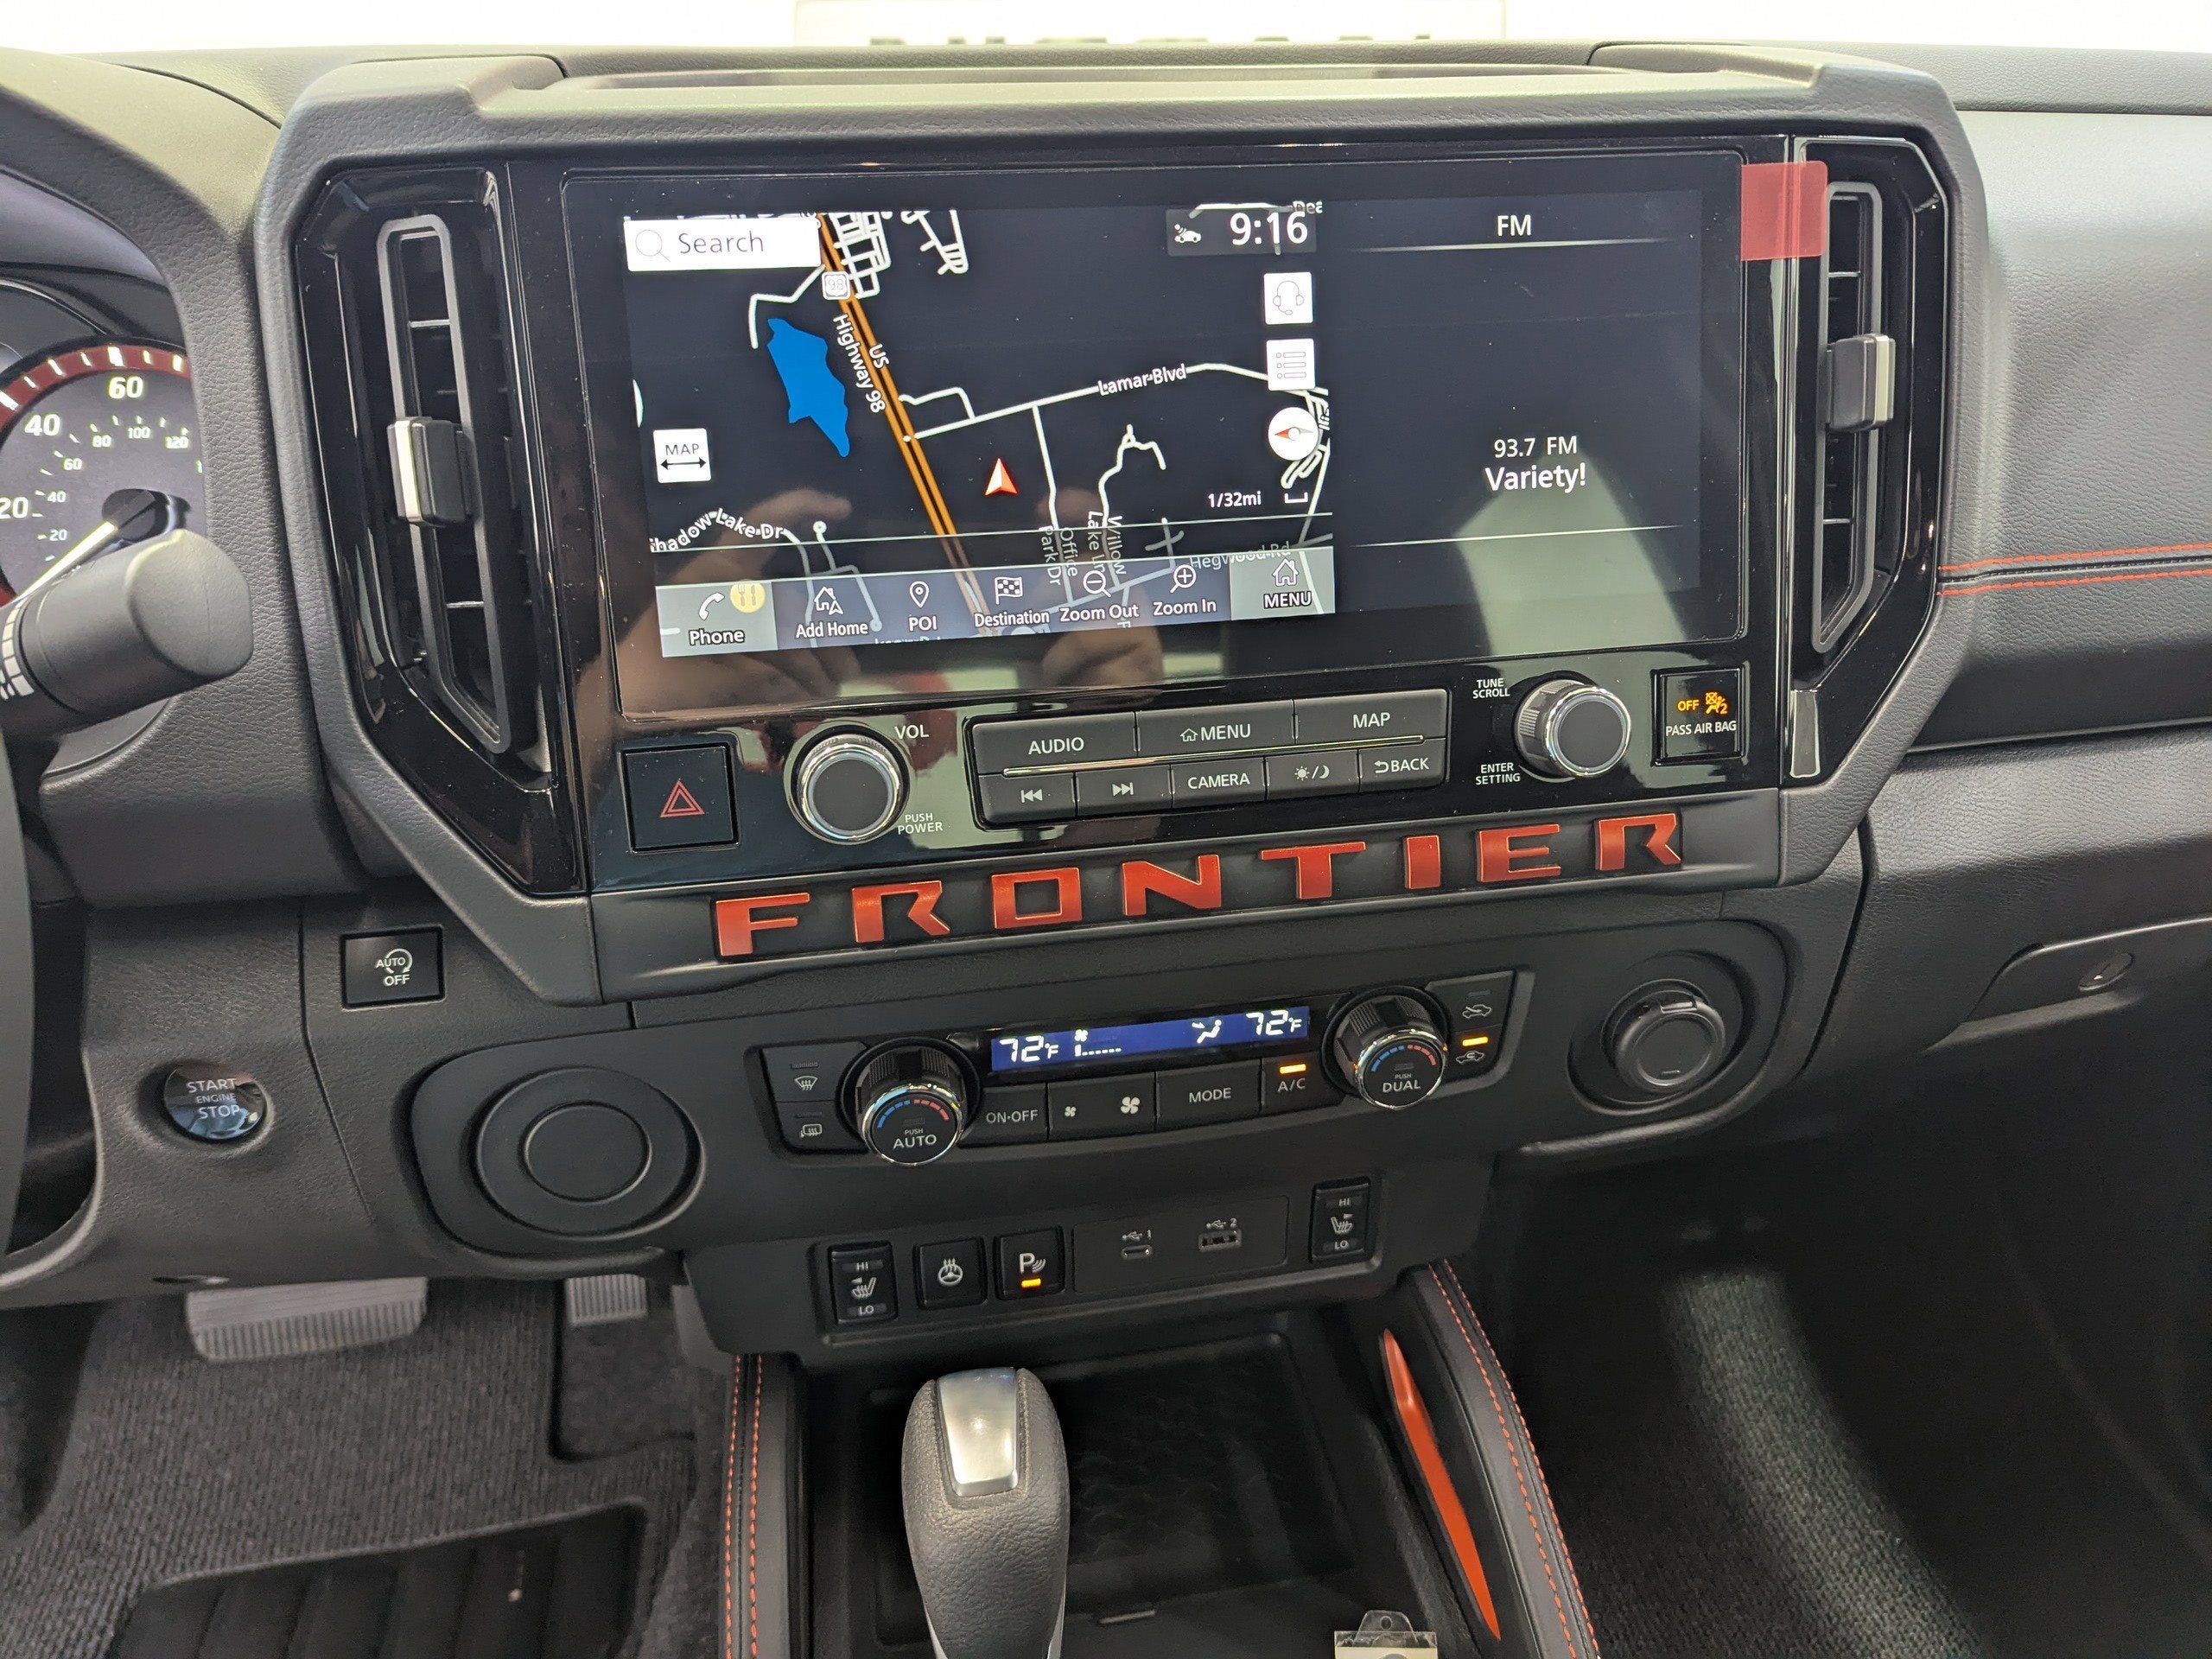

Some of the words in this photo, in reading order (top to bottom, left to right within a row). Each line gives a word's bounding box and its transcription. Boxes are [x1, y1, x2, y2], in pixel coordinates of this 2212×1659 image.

[1230, 211, 1308, 245] 9:16
[1497, 214, 1532, 237] FM
[677, 229, 765, 255] Search
[827, 278, 846, 292] 98
[832, 314, 874, 389] Highway
[865, 390, 887, 413] 98
[869, 344, 890, 368] US
[108, 376, 144, 398] 60
[1097, 376, 1151, 396] Lamar
[1152, 363, 1187, 385] Blvd
[24, 413, 61, 436] 40
[128, 426, 151, 439] 100
[92, 435, 112, 448] 80
[664, 442, 700, 456] MAP
[1493, 437, 1536, 459] 93.7
[1547, 435, 1578, 455] FM
[63, 458, 83, 471] 60
[1484, 462, 1586, 493] Variety!
[47, 490, 67, 503] 40
[1207, 490, 1262, 509] 1/32mi
[0, 496, 29, 518] 20
[715, 507, 756, 538] Lake
[760, 523, 784, 540] Dr
[1087, 511, 1103, 550] Lake
[49, 528, 67, 541] 20
[1039, 525, 1059, 563] Park
[1047, 566, 1062, 586] Dr
[1153, 600, 1198, 616] Zoom
[1201, 598, 1217, 613] In
[1263, 590, 1313, 609] MENU
[974, 609, 1050, 628] Destination
[1059, 607, 1106, 622] Zoom
[1109, 604, 1140, 619] Out
[795, 623, 824, 639] Add
[827, 621, 868, 638] Home
[908, 615, 938, 632] POI
[689, 628, 746, 646] Phone
[1476, 677, 1504, 689] TUNE
[1472, 686, 1510, 700] SCROLL
[1677, 698, 1700, 712] OFF
[1352, 712, 1391, 729] MAP
[1665, 723, 1693, 737] PASS
[1694, 722, 1713, 734] AIR
[1714, 720, 1737, 733] BAG
[893, 723, 930, 741] VOL
[1200, 722, 1251, 741] MENU
[1027, 735, 1085, 756] AUDIO
[1390, 756, 1430, 773] BACK
[1480, 761, 1514, 775] ENTER
[1186, 772, 1251, 791] CAMERA
[1474, 772, 1521, 786] SETTING
[904, 811, 934, 823] PUSH
[897, 820, 944, 836] POWER
[715, 812, 1683, 957] FRONTIER
[375, 957, 407, 970] AUTO
[383, 973, 410, 987] OFF
[1394, 1071, 1412, 1080] PUSH
[186, 1077, 236, 1094] START
[1277, 1077, 1306, 1093] A/C
[1382, 1079, 1421, 1093] DUAL
[195, 1092, 237, 1105] ENGINE
[1188, 1086, 1232, 1104] MODE
[197, 1103, 241, 1121] STOP
[903, 1128, 924, 1136] PUSH
[893, 1133, 938, 1150] AUTO
[1338, 1198, 1351, 1207] HI
[1229, 1217, 1237, 1229] 2
[1334, 1240, 1350, 1250] LO
[855, 1260, 869, 1272] HI
[858, 1304, 874, 1316] LO
